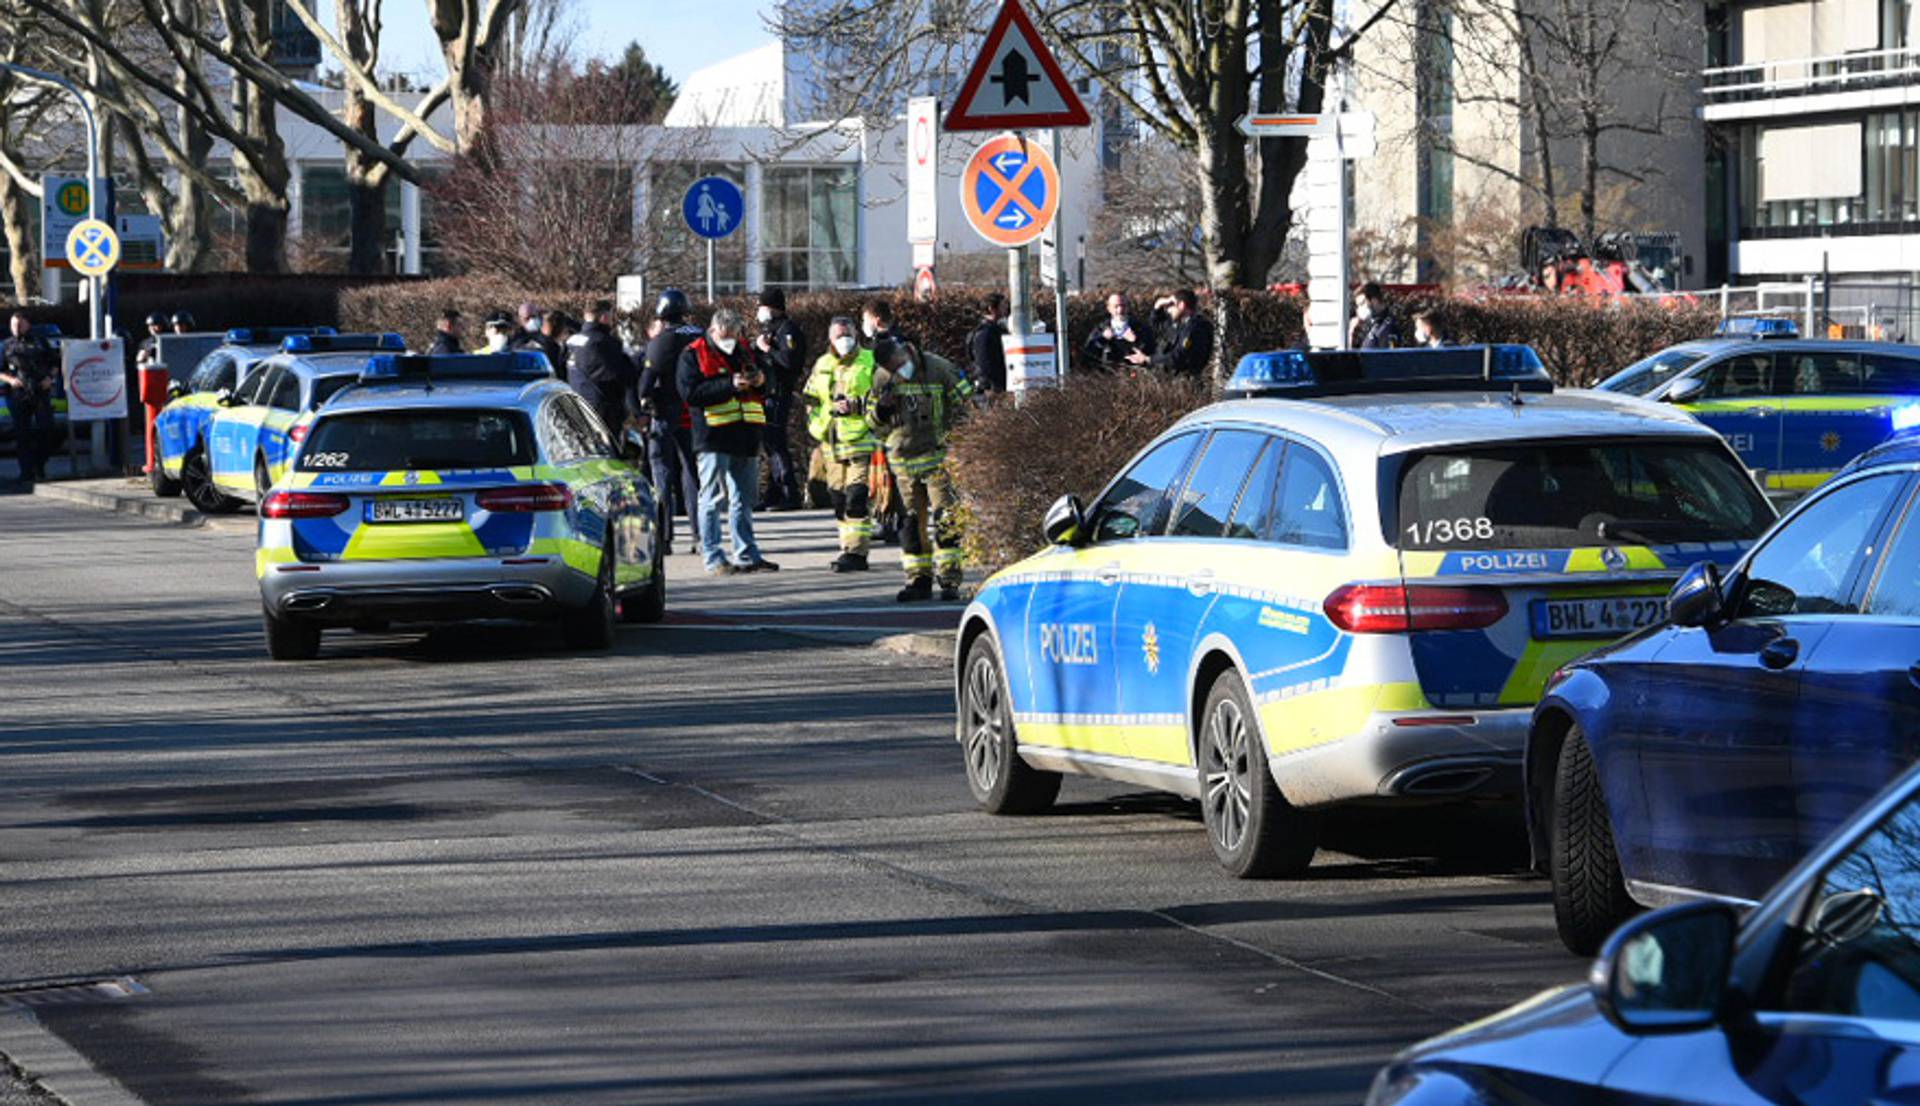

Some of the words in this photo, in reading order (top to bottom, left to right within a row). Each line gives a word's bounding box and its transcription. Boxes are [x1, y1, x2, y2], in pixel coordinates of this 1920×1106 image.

[302, 452, 349, 467] 1/262
[323, 473, 372, 484] POLIZEI
[374, 501, 401, 519] BWL
[1406, 517, 1495, 544] 1/368
[1461, 552, 1548, 570] POLIZEI
[1549, 602, 1595, 630] BWL
[1041, 623, 1098, 664] POLIZEI
